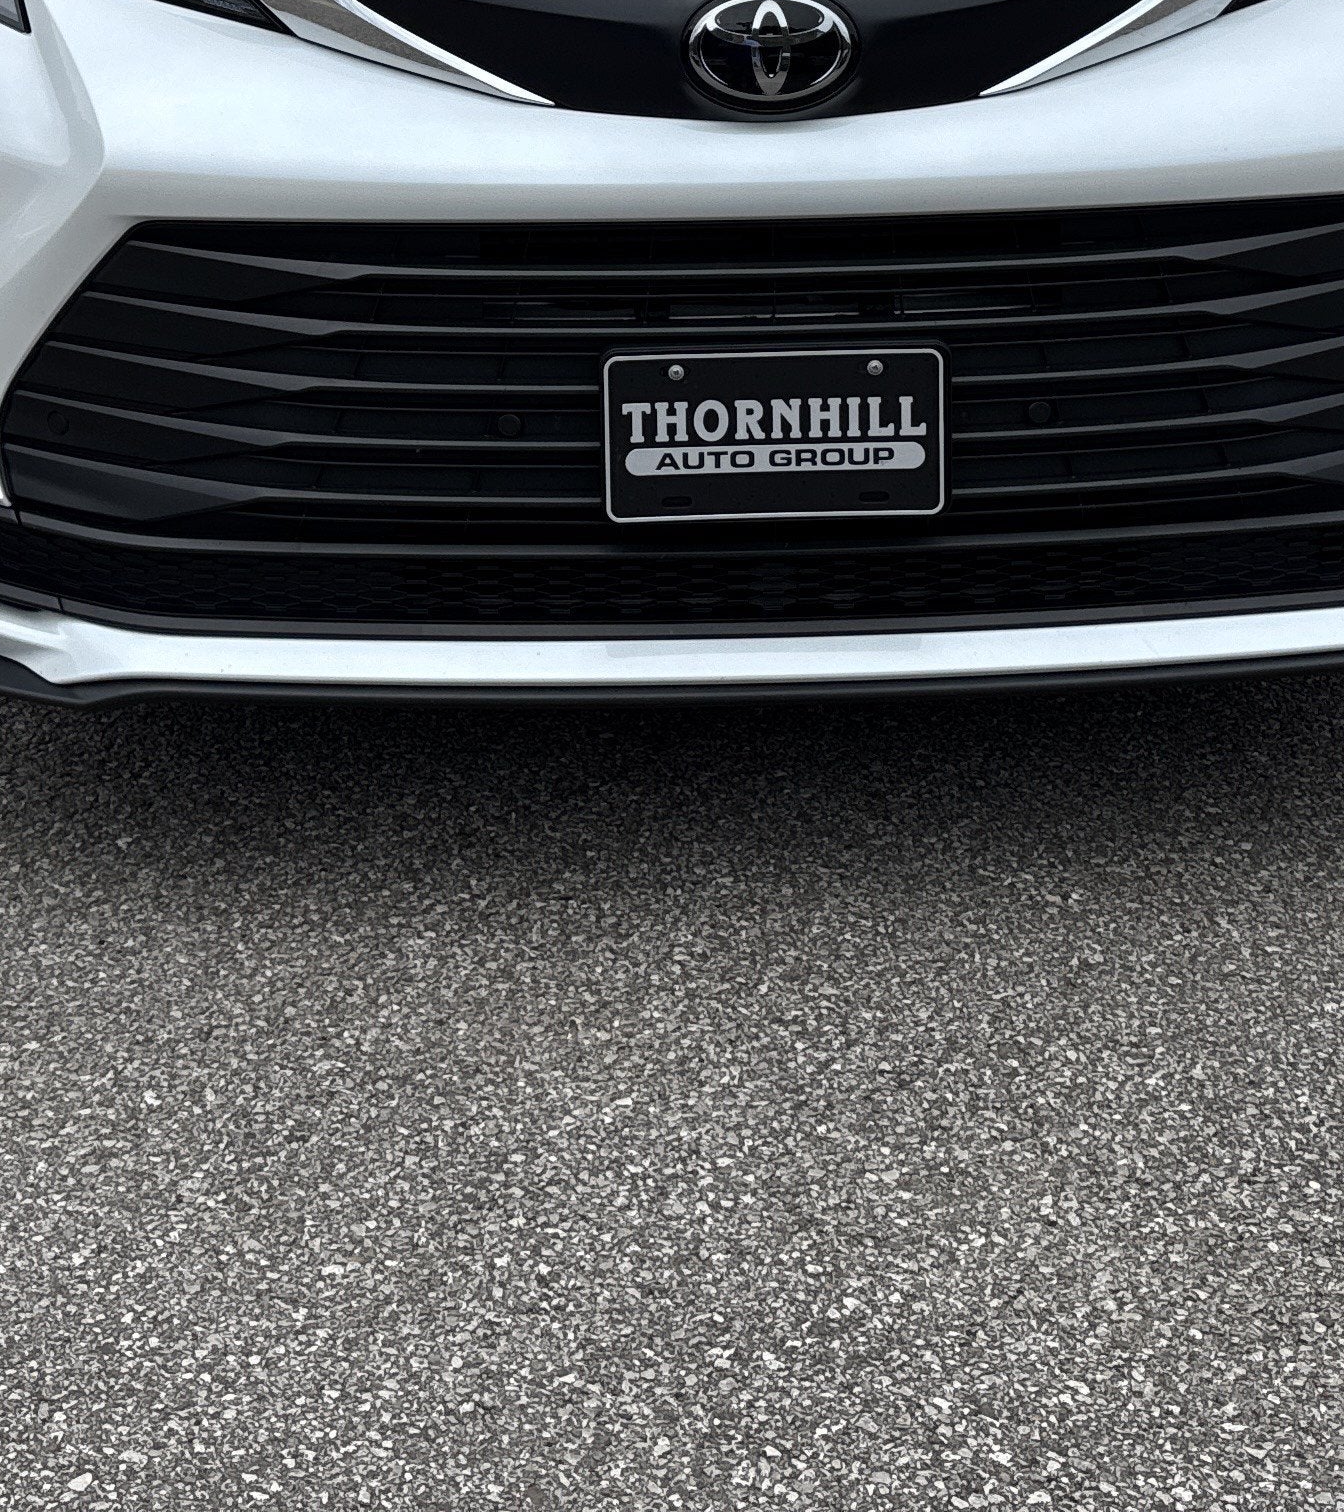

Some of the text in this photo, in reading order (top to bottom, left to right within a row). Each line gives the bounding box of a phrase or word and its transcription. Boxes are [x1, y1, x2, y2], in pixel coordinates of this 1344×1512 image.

[621, 396, 927, 443] THORNHILL
[655, 447, 896, 471] AUTO GROUP
